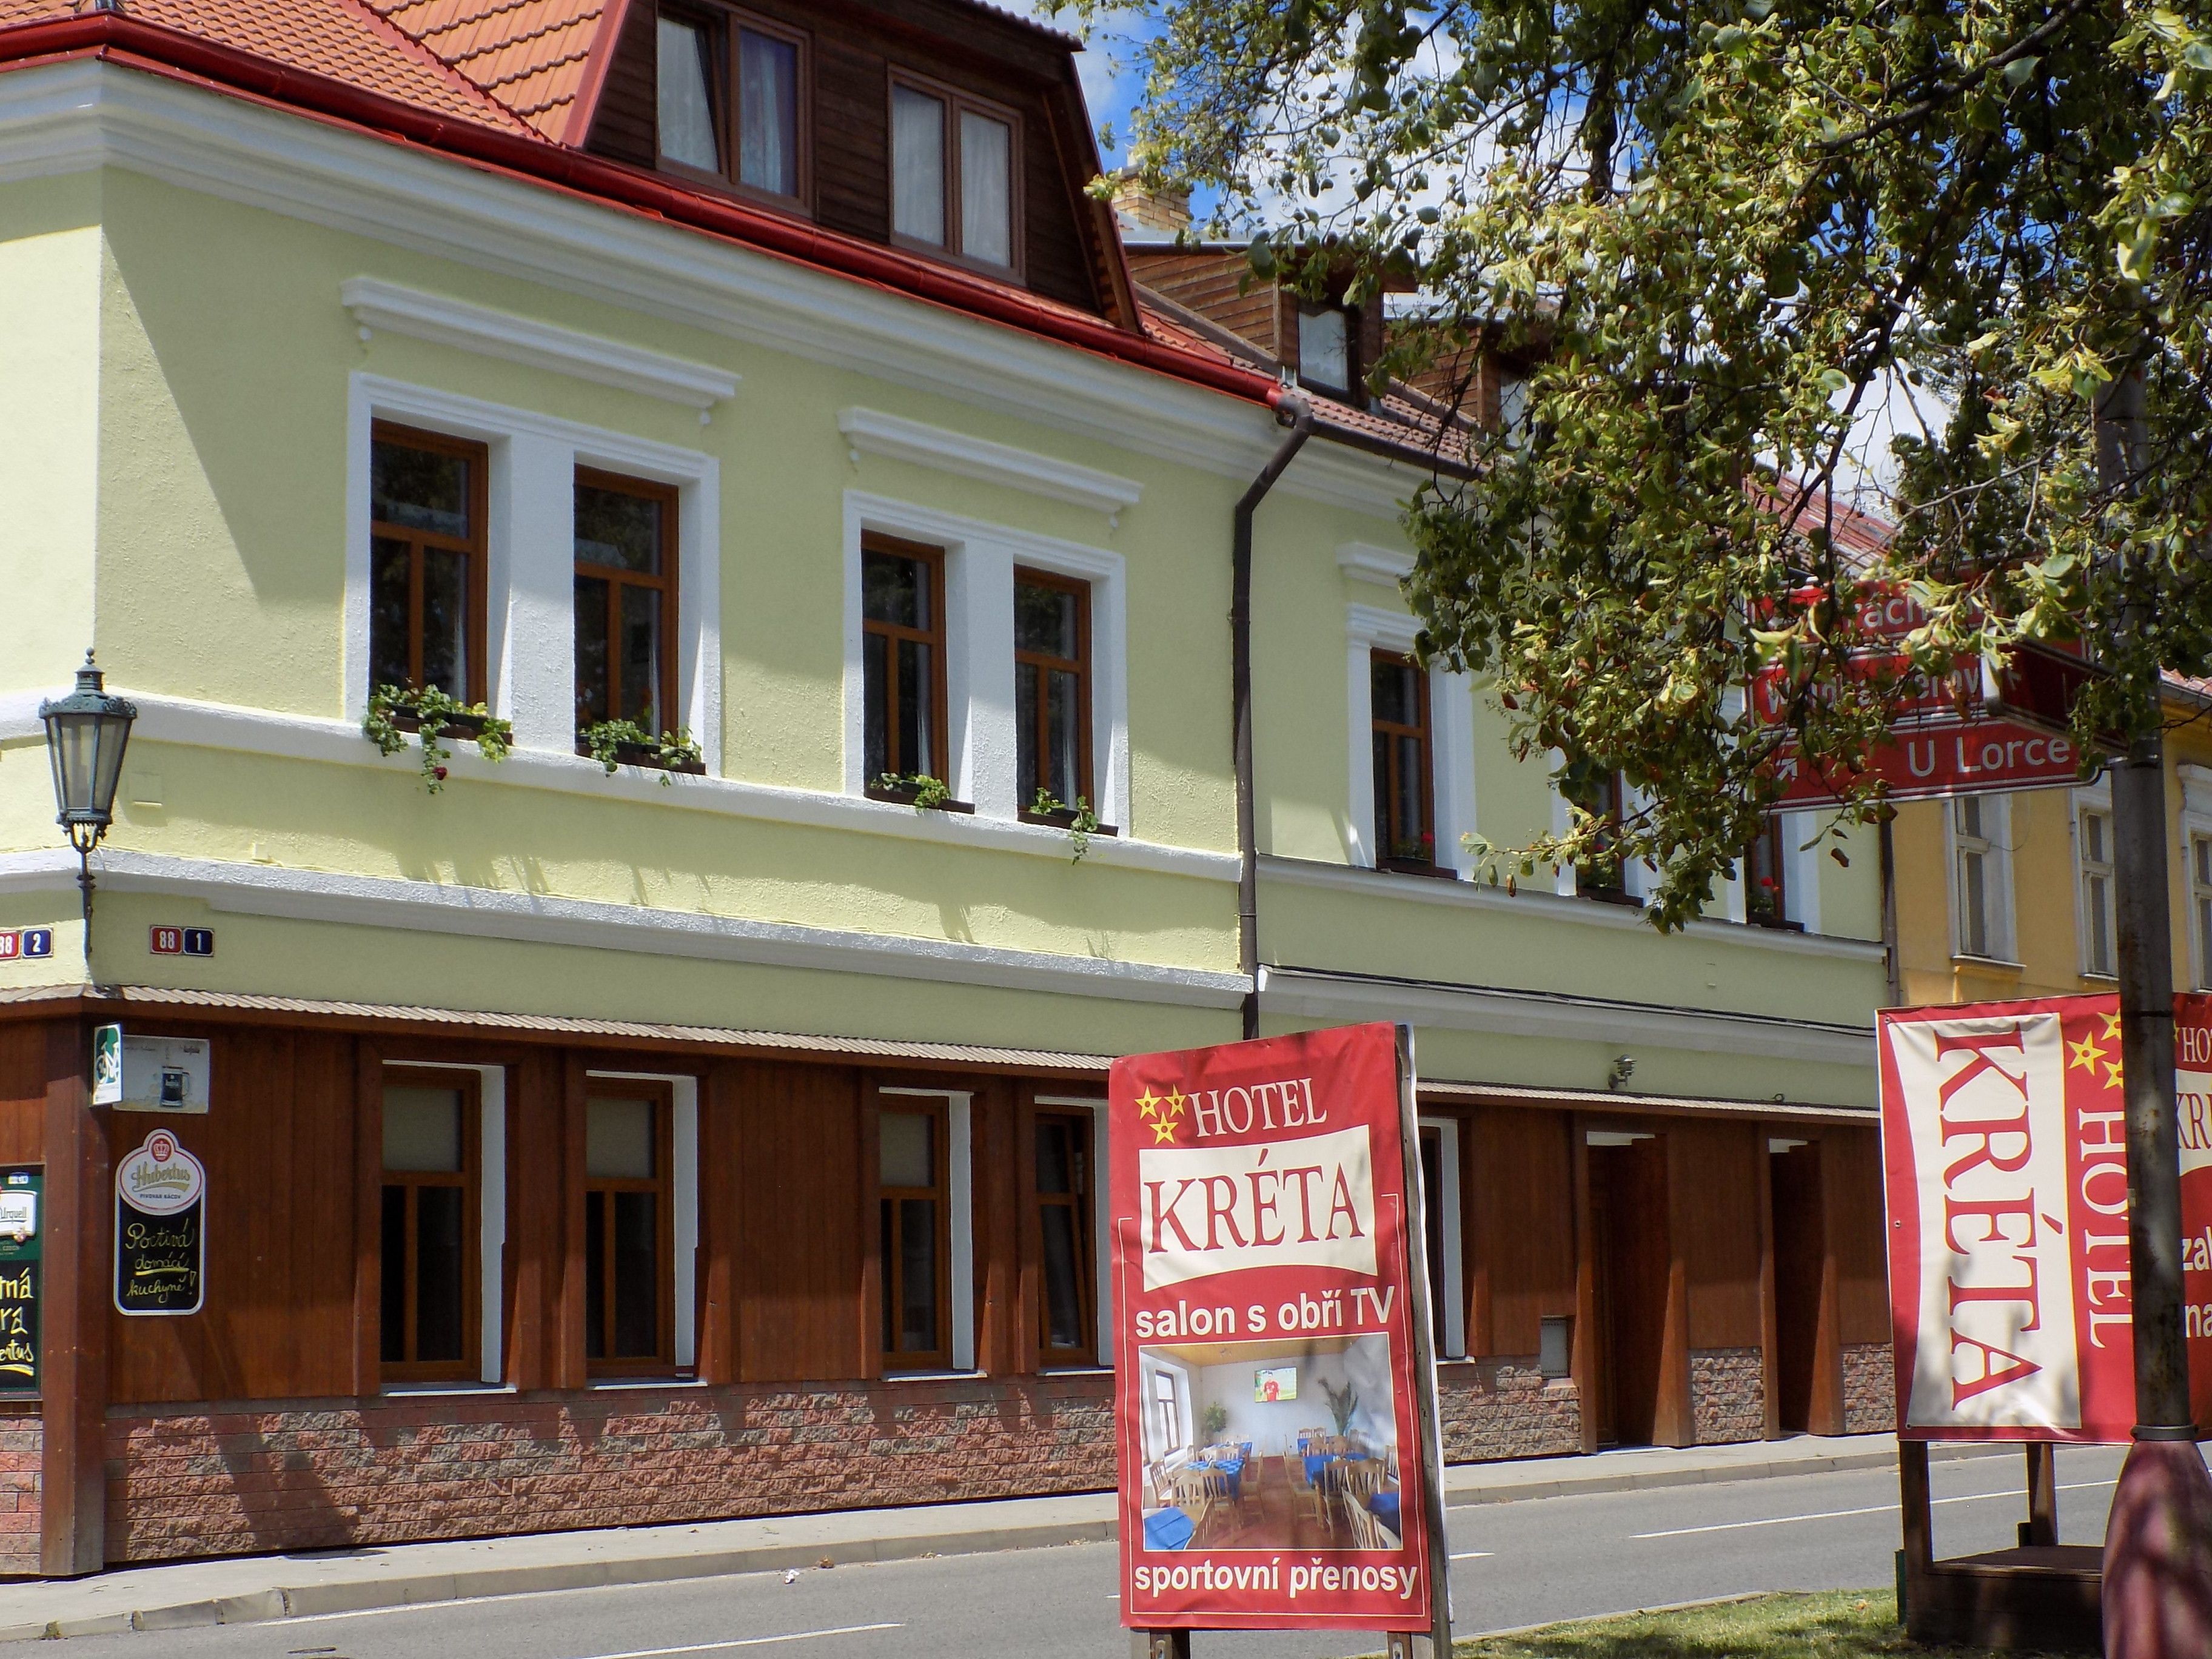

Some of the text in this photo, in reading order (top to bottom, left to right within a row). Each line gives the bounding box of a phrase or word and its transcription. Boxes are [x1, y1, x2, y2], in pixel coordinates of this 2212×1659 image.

[1909, 736, 2071, 777] U Lorce
[33, 933, 41, 952] 2
[159, 931, 175, 949] 88
[196, 933, 202, 951] 1
[2183, 1027, 2212, 1063] HO
[1188, 1078, 1327, 1138] HOTEL
[2177, 1093, 2212, 1150] KR
[131, 1161, 190, 1188] Hubertus
[1144, 1148, 1365, 1253] KRÉTA
[1934, 1022, 2063, 1411] KRÉTA
[126, 1218, 195, 1249] Poctivá
[135, 1252, 189, 1269] domácí
[1136, 1286, 1394, 1338] salon s obří TV
[1134, 1557, 1418, 1600] sportovní přenosy
